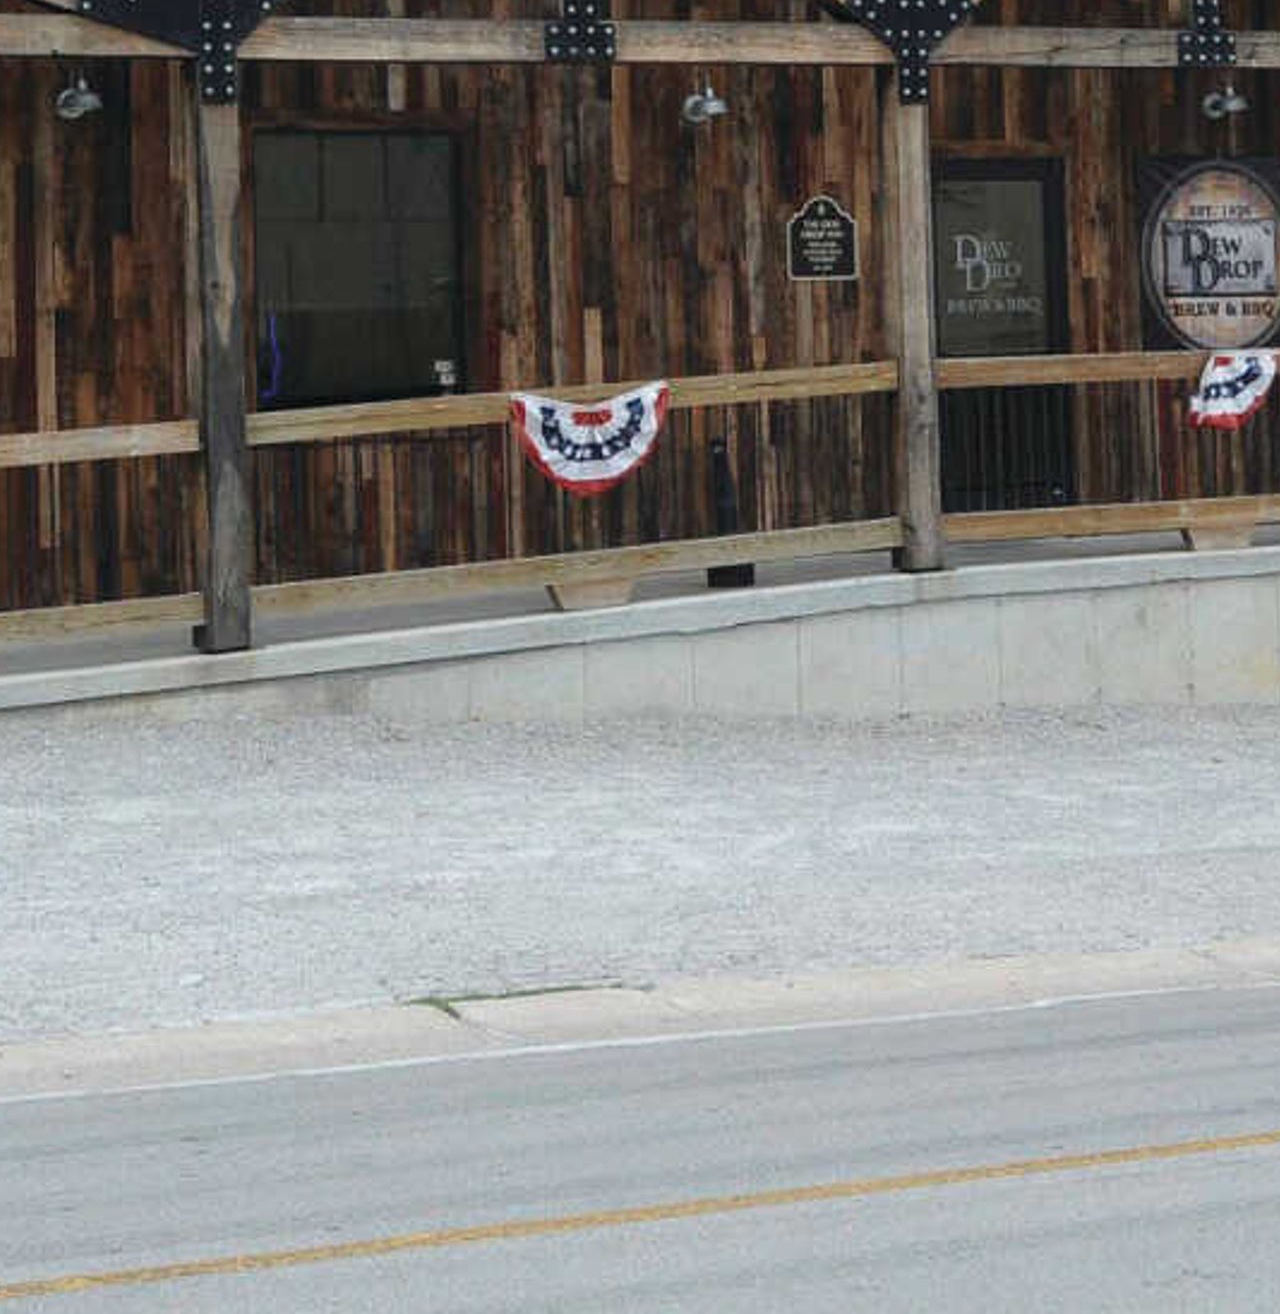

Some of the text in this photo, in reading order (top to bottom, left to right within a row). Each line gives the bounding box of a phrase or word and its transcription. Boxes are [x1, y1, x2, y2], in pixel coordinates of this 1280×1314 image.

[1179, 228, 1243, 266] DEW
[1190, 255, 1264, 290] DROP
[1173, 300, 1220, 318] BREW
[1242, 300, 1276, 319] BBQ
